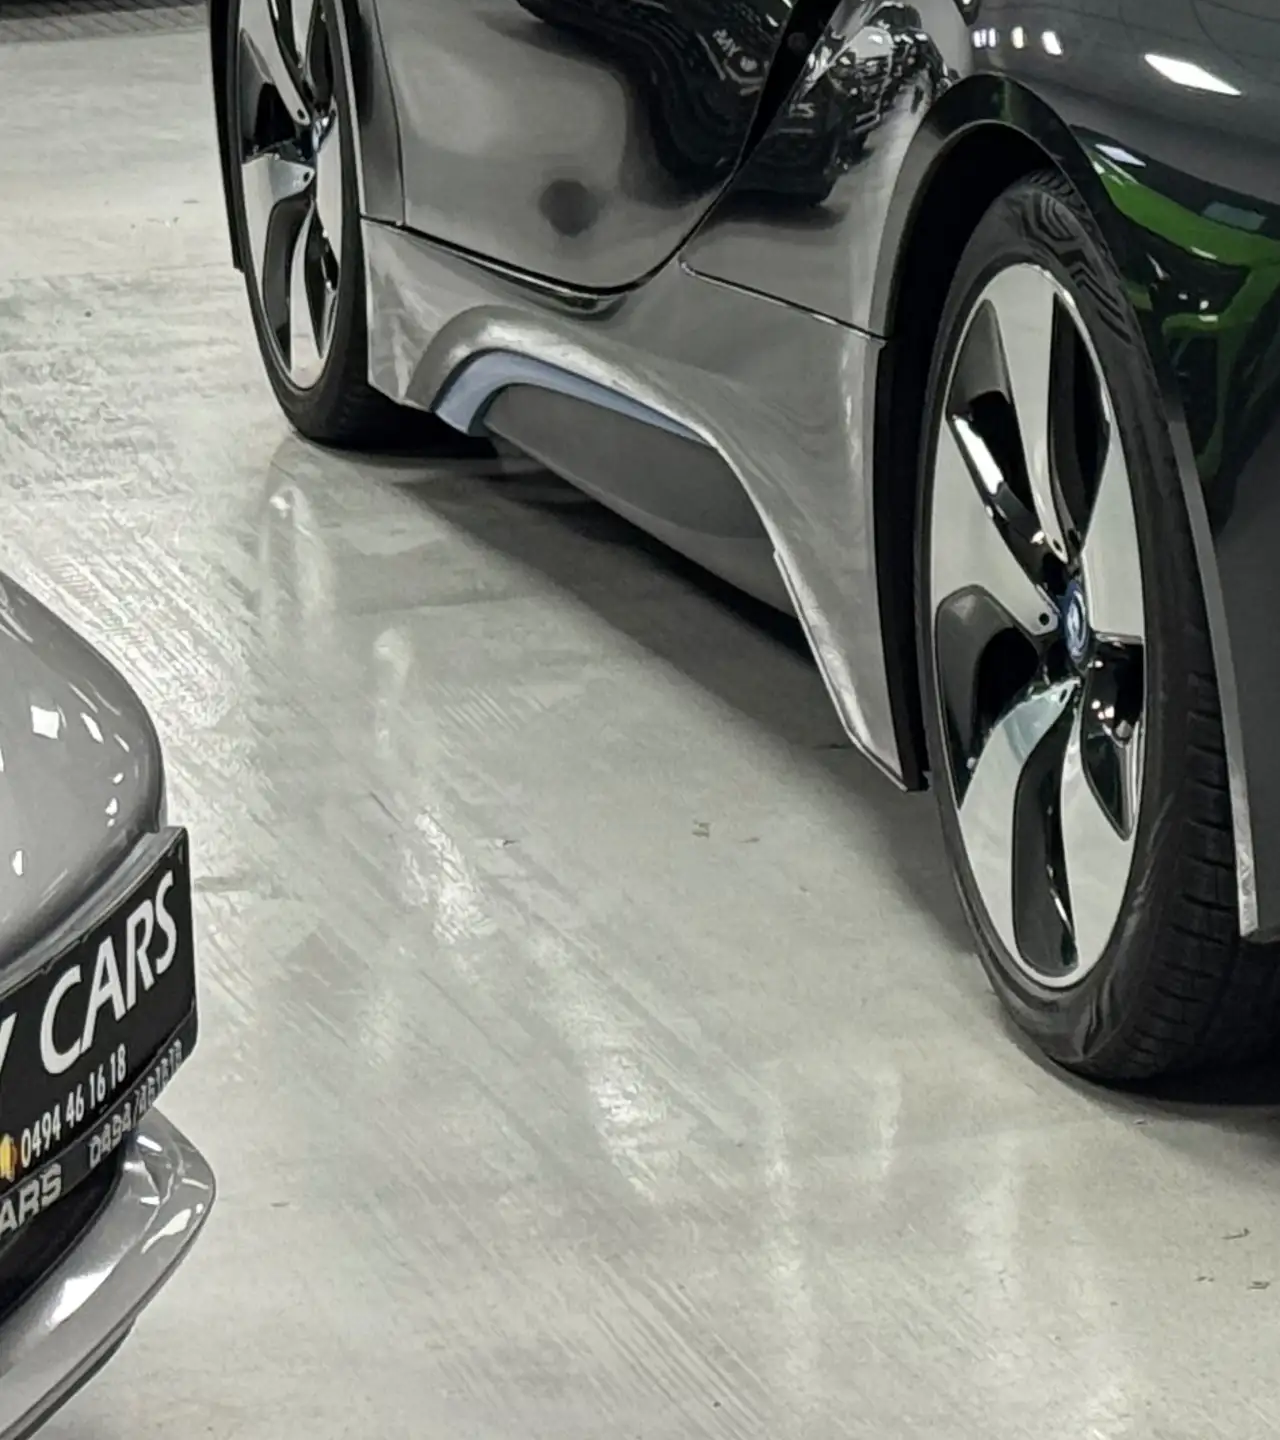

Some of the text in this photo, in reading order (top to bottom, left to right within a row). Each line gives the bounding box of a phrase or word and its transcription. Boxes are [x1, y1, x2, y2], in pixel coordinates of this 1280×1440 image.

[39, 869, 178, 1075] CARS
[20, 1043, 127, 1169] 0494 46 16 18
